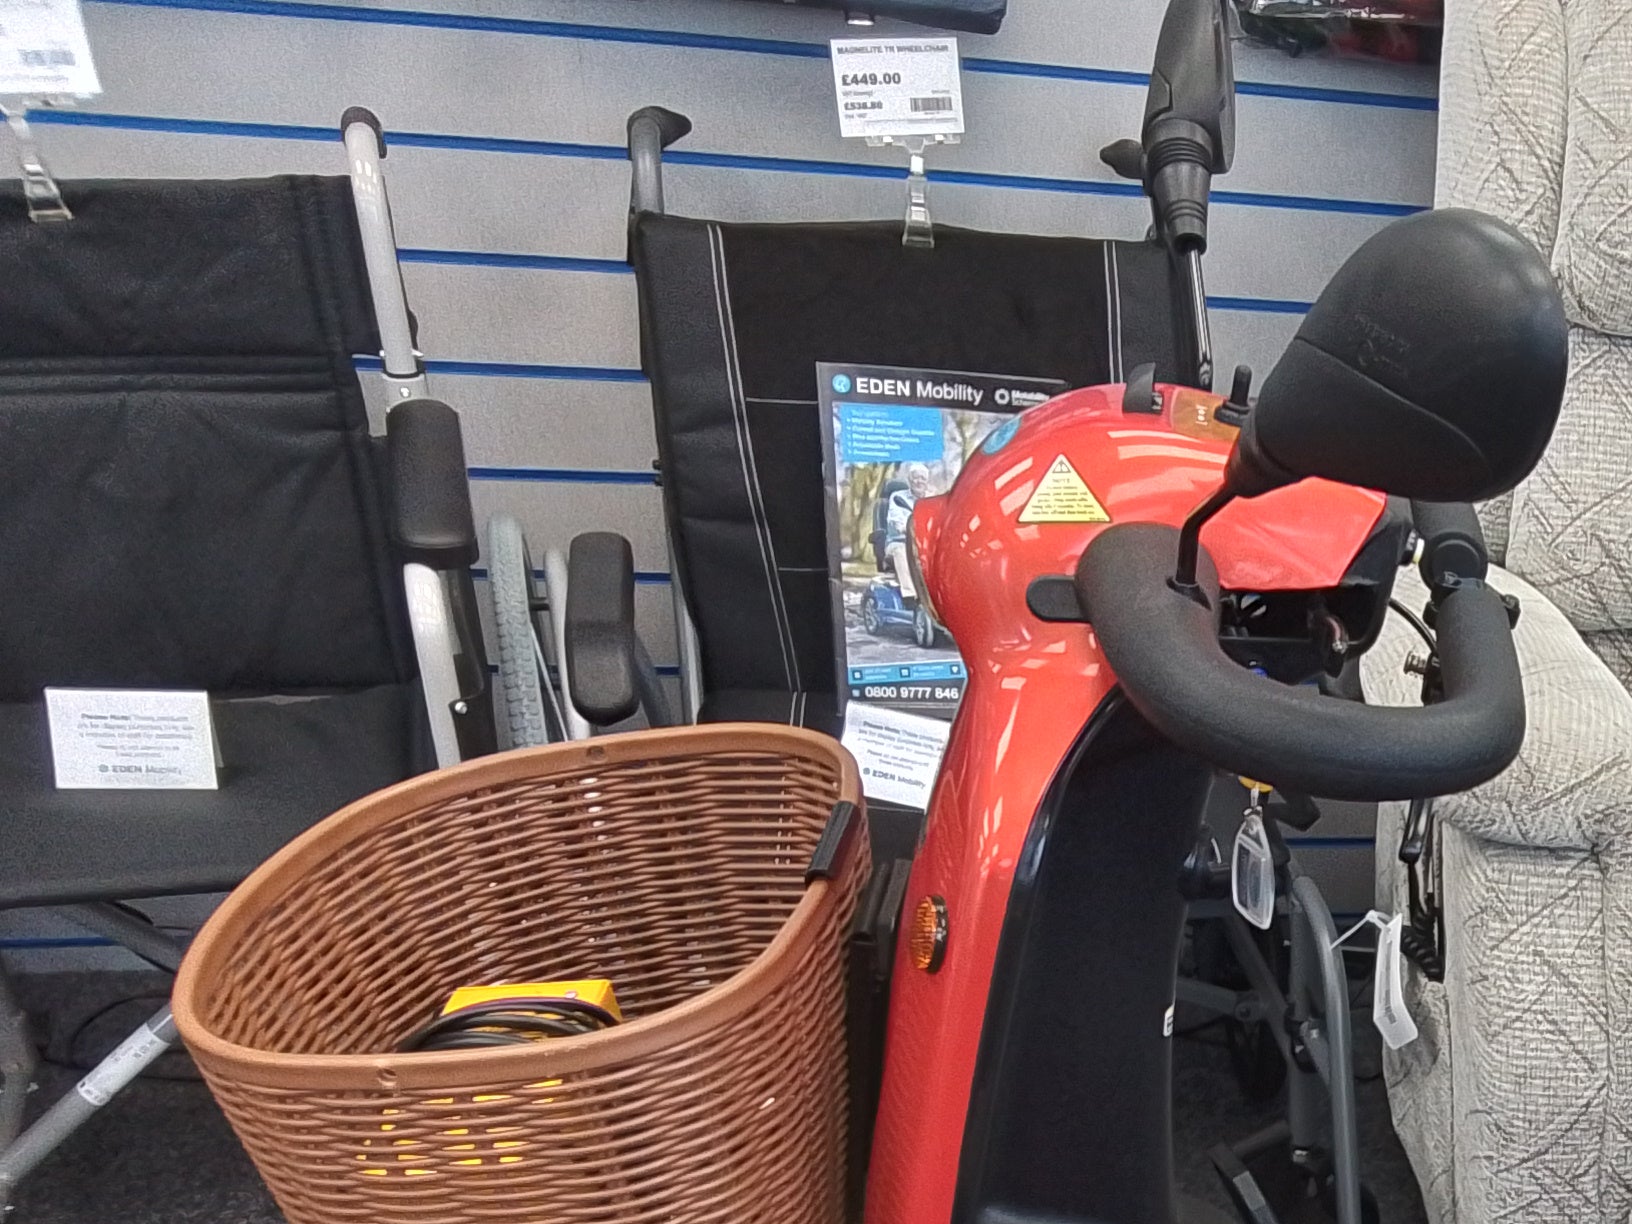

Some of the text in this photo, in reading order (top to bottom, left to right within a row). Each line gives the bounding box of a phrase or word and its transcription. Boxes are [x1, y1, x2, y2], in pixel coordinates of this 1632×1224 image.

[842, 72, 901, 86] £449.00
[856, 377, 984, 406] EDEN Mobility
[864, 686, 959, 700] 0800 9777 846
[112, 765, 142, 774] EDEN
[872, 769, 896, 782] EDEN
